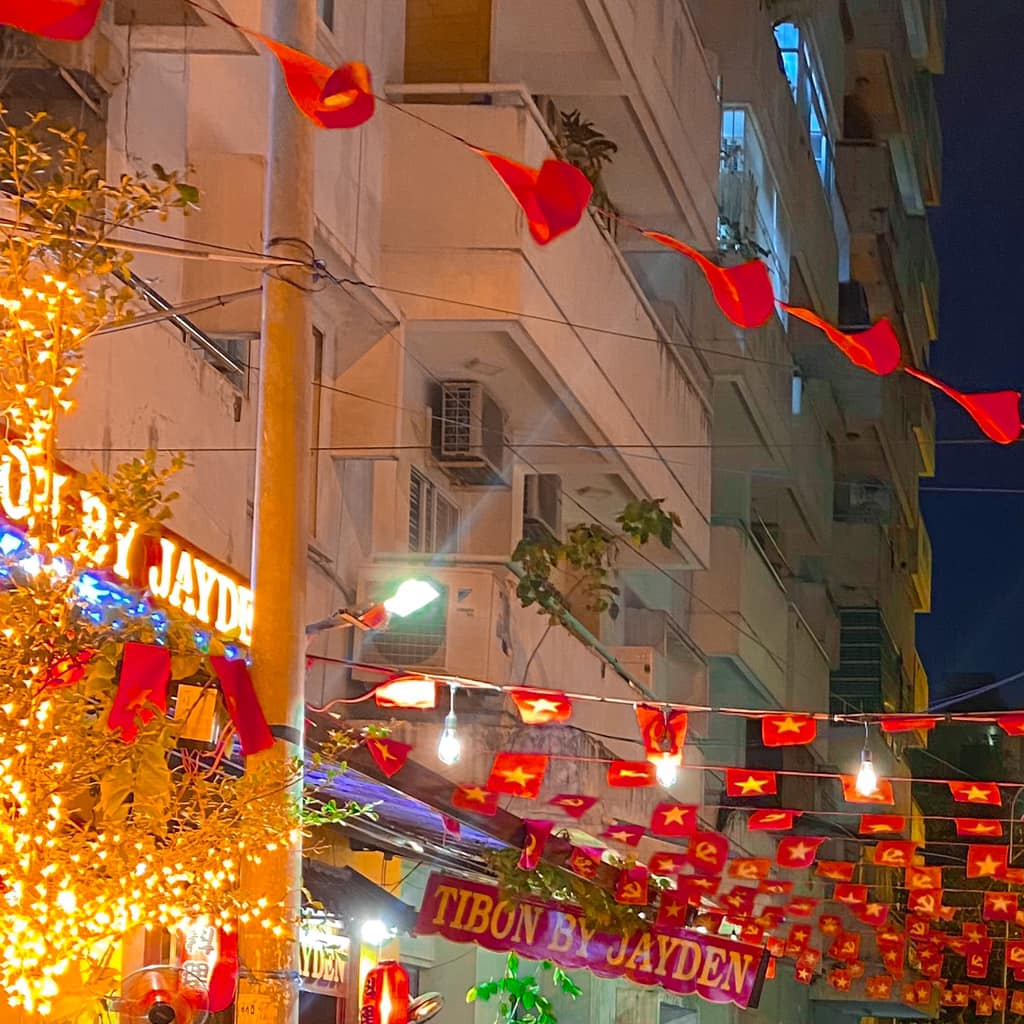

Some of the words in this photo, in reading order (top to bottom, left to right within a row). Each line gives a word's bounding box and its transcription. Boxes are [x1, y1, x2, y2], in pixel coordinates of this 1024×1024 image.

[298, 943, 345, 983] YDEN
[432, 884, 545, 946] TIBON
[548, 910, 599, 954] BY
[605, 928, 753, 994] JAYDEN
